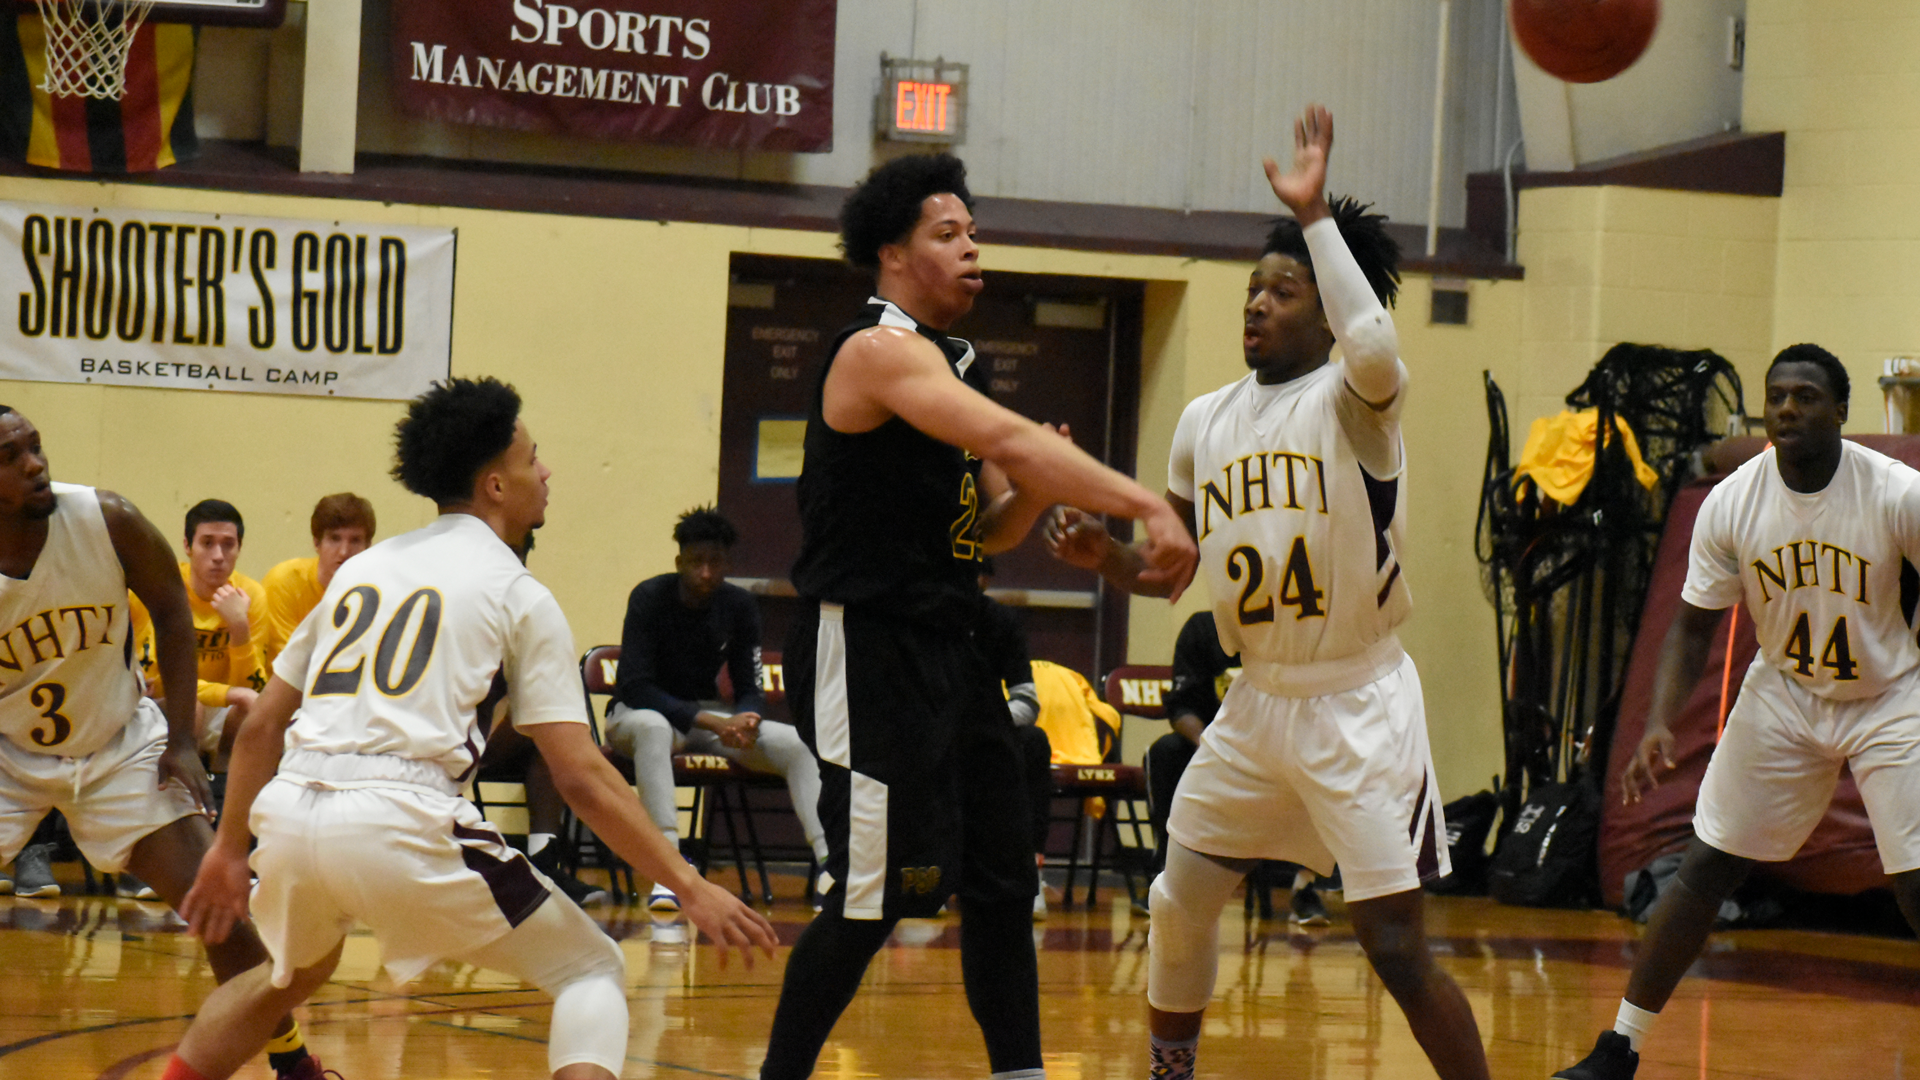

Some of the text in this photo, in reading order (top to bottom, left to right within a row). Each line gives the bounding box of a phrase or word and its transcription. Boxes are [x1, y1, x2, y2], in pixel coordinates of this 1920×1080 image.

[511, 0, 711, 60] SPORTS
[410, 42, 801, 116] MANAGEMENT CLUB
[896, 81, 951, 131] EXIT
[19, 213, 407, 356] SHOOTER'S GOLD
[80, 358, 339, 386] BASKETBALL CAMP
[950, 472, 983, 563] 2
[1199, 452, 1329, 541] NHTI
[1226, 534, 1327, 627] 24
[1750, 539, 1872, 605] NHTI
[307, 583, 445, 699] 20
[1784, 610, 1860, 681] 44
[30, 681, 72, 747] 3
[685, 755, 729, 770] LYNX
[1078, 768, 1115, 781] LYNX
